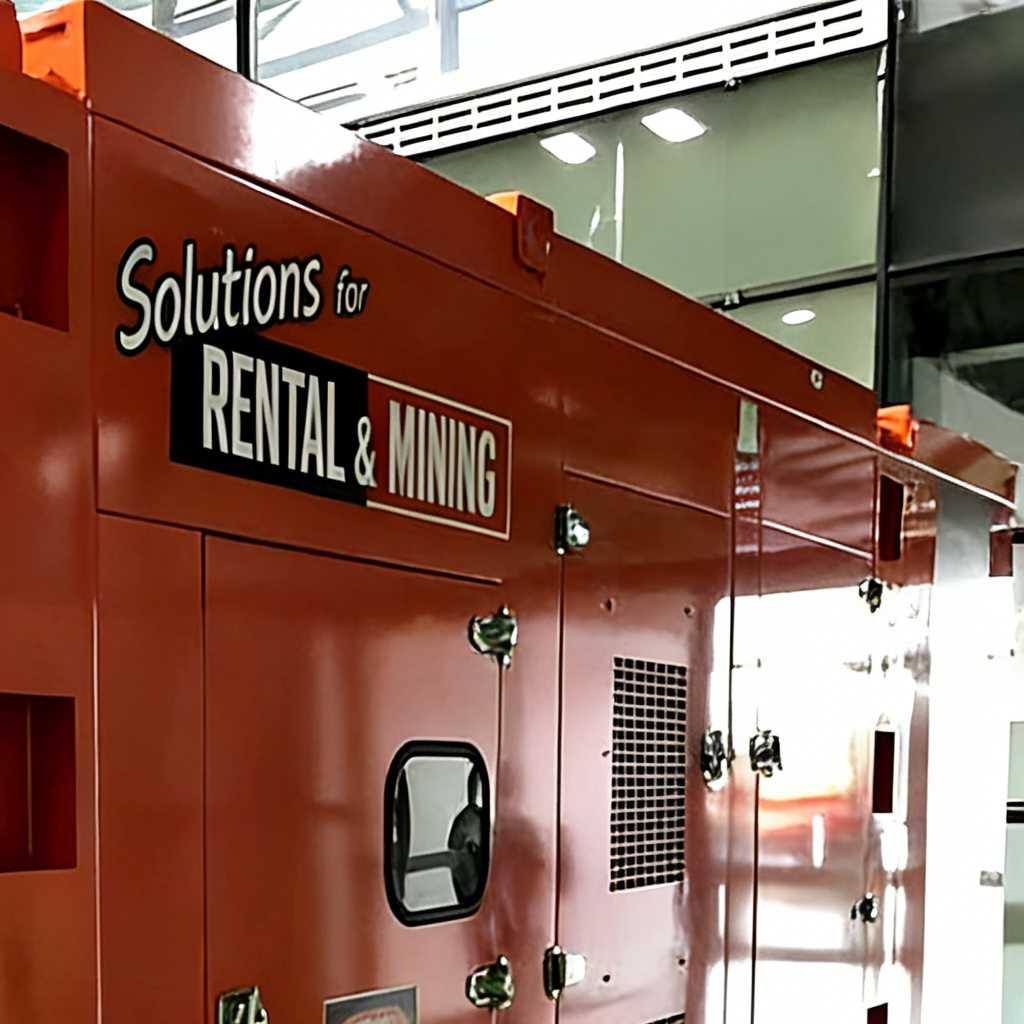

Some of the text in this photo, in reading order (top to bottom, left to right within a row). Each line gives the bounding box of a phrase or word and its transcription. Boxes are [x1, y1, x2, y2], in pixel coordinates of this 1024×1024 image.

[118, 241, 369, 352] Solutions for
[202, 343, 496, 518] RENTAL & MINING
